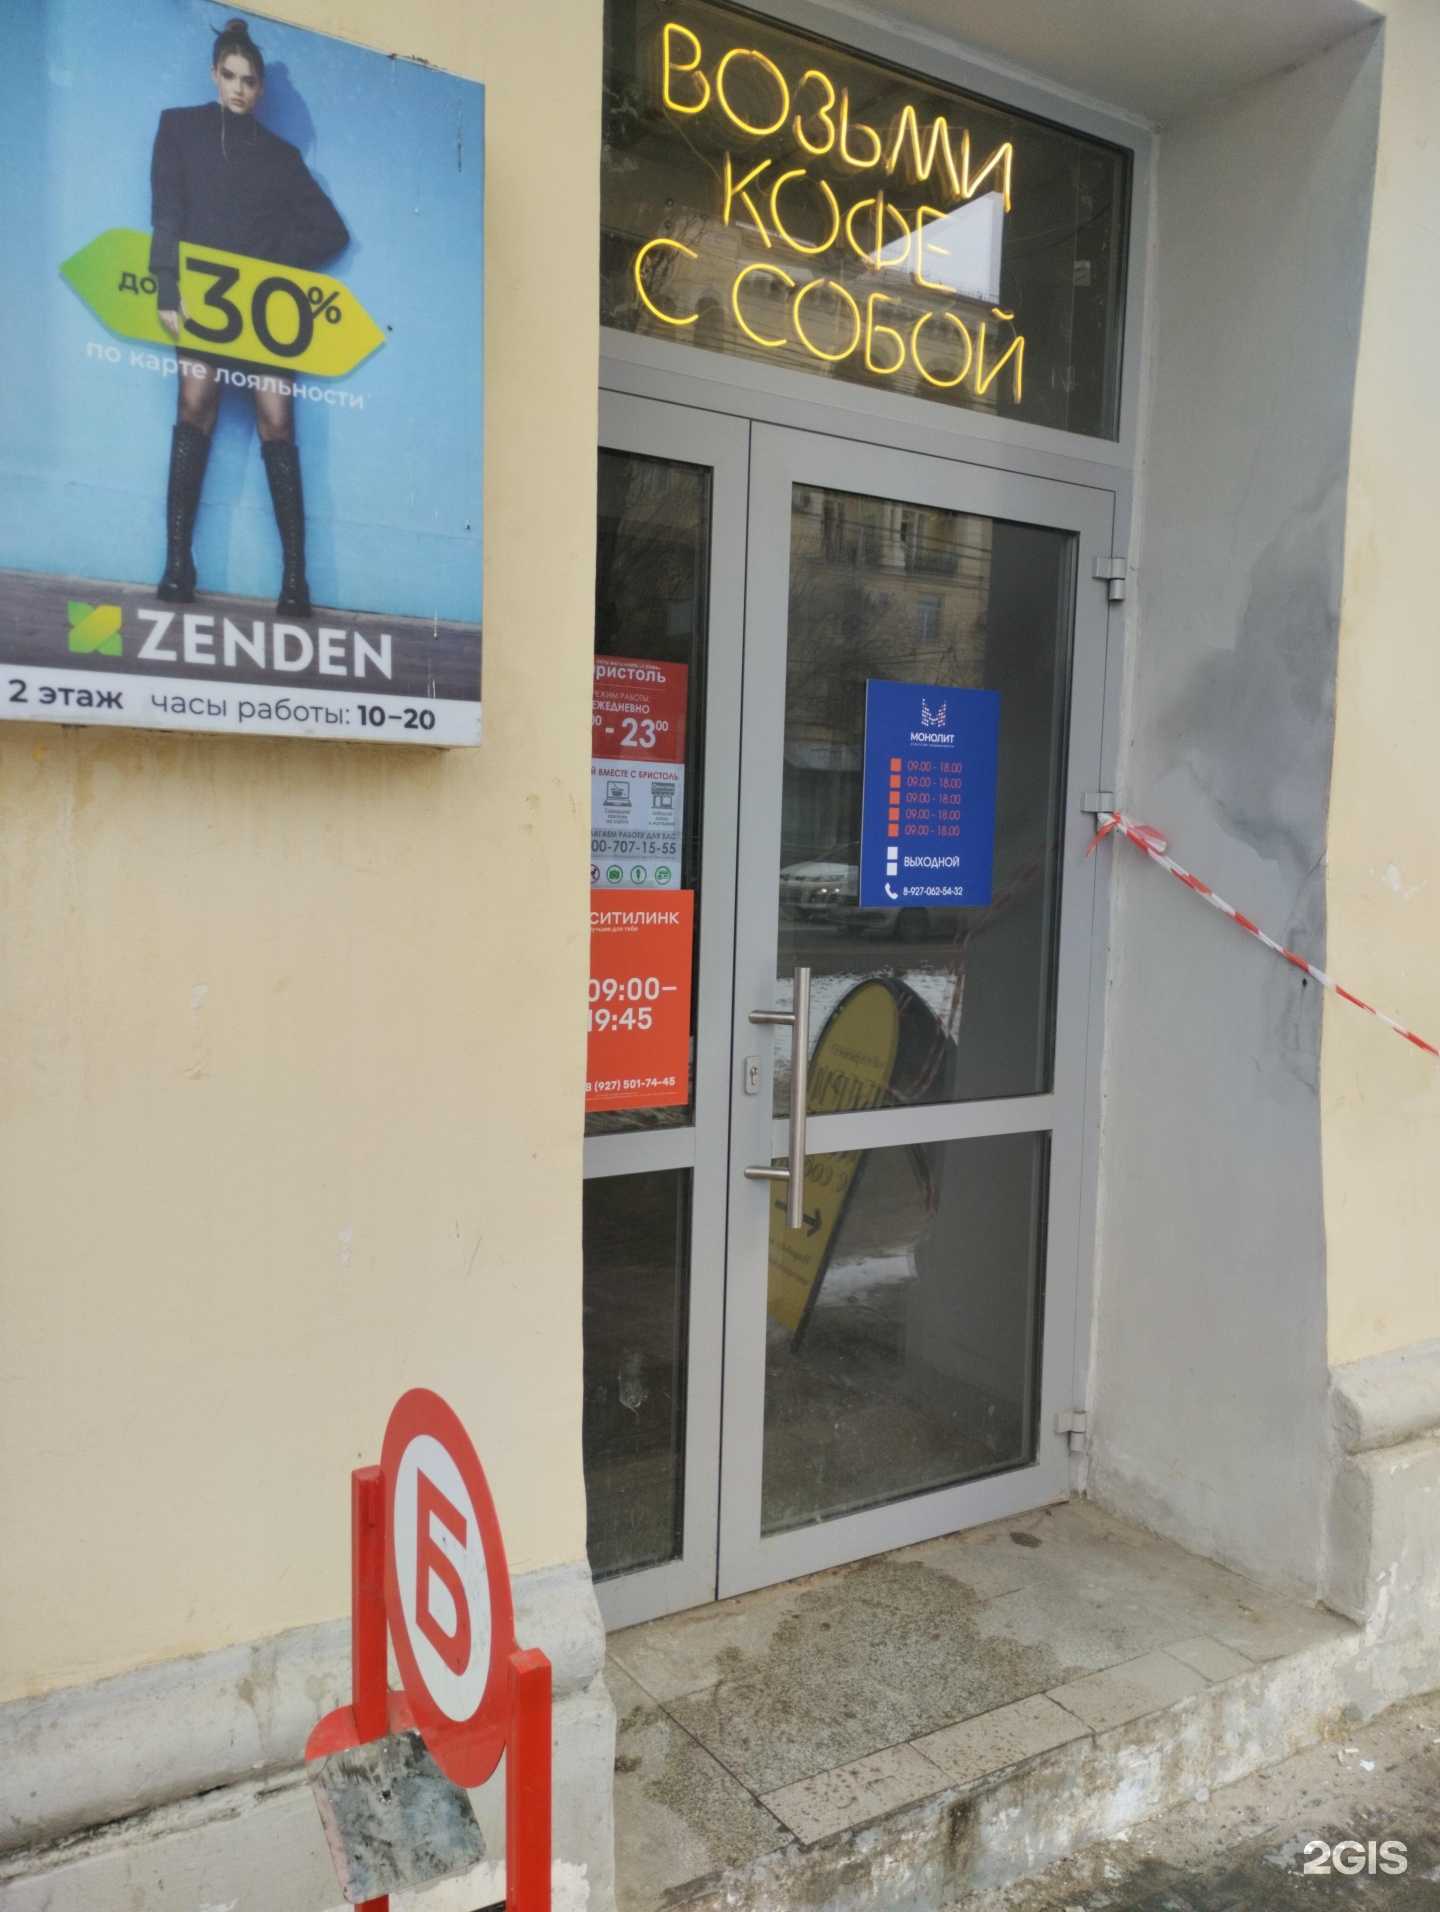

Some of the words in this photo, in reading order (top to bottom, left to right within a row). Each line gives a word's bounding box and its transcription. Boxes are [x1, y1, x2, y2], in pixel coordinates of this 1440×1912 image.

[663, 23, 1013, 213] ВОЗЬМИ
[723, 151, 957, 293] КОФЕ
[118, 271, 157, 295] до
[634, 238, 699, 325] С
[732, 263, 1025, 404] СОБОЙ
[86, 341, 122, 363] по
[129, 350, 208, 379] карте
[137, 608, 392, 680] ZENDEN
[8, 679, 28, 703] 2
[38, 685, 124, 710] этаж
[151, 694, 227, 717] часы
[239, 698, 351, 725] работы:
[910, 731, 956, 744] МОНОЛИТ
[598, 767, 628, 778] ВМЕСТЕ
[630, 770, 637, 778] С
[904, 855, 960, 870] ВЫХОДНОЙ
[590, 911, 681, 925] СИТИЛИНК
[594, 1079, 621, 1093] (927)
